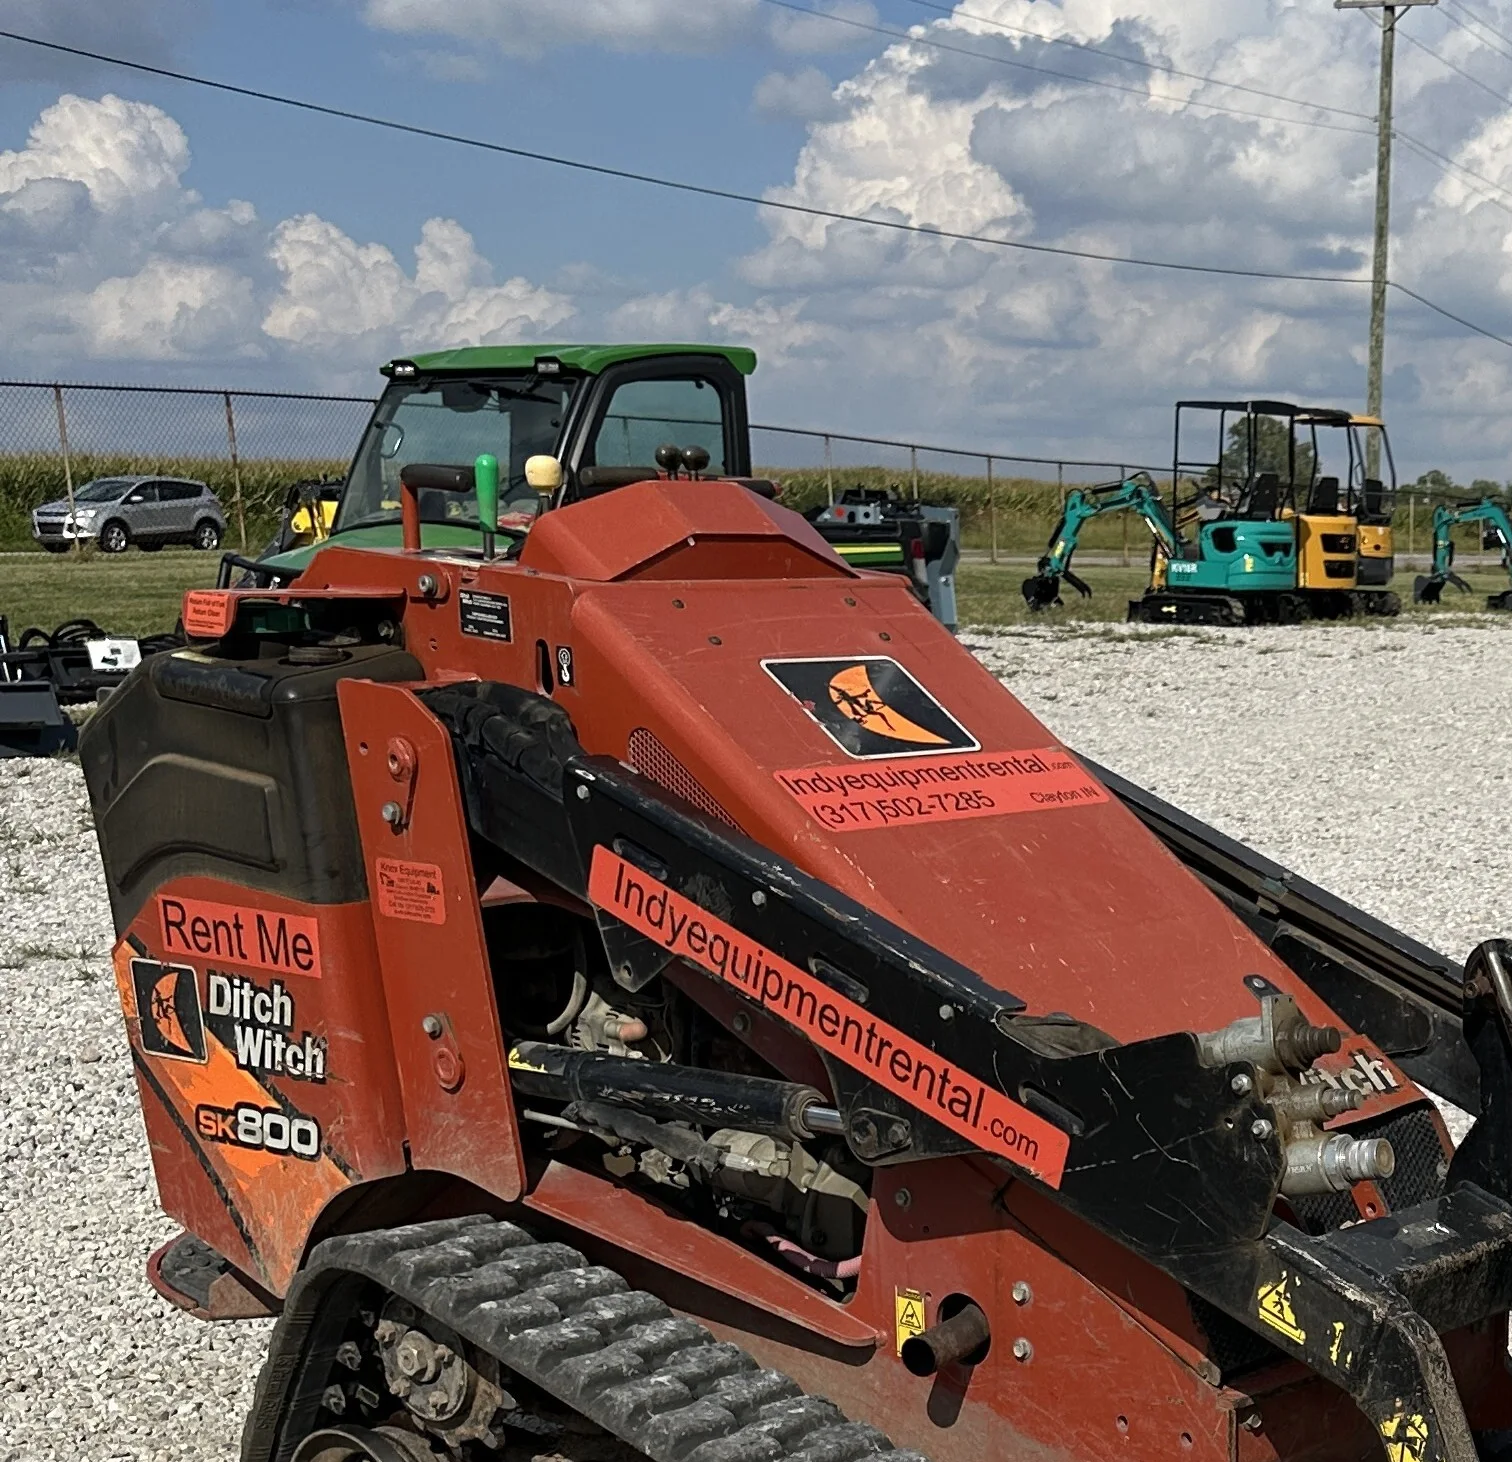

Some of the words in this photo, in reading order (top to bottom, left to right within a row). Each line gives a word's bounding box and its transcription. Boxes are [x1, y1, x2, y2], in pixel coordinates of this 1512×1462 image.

[812, 788, 996, 829] (317)502-7285
[161, 899, 248, 960] Rent
[256, 913, 315, 971] Me
[208, 972, 293, 1028] Ditch
[234, 1022, 325, 1080] Witch
[198, 1106, 319, 1156] SK800
